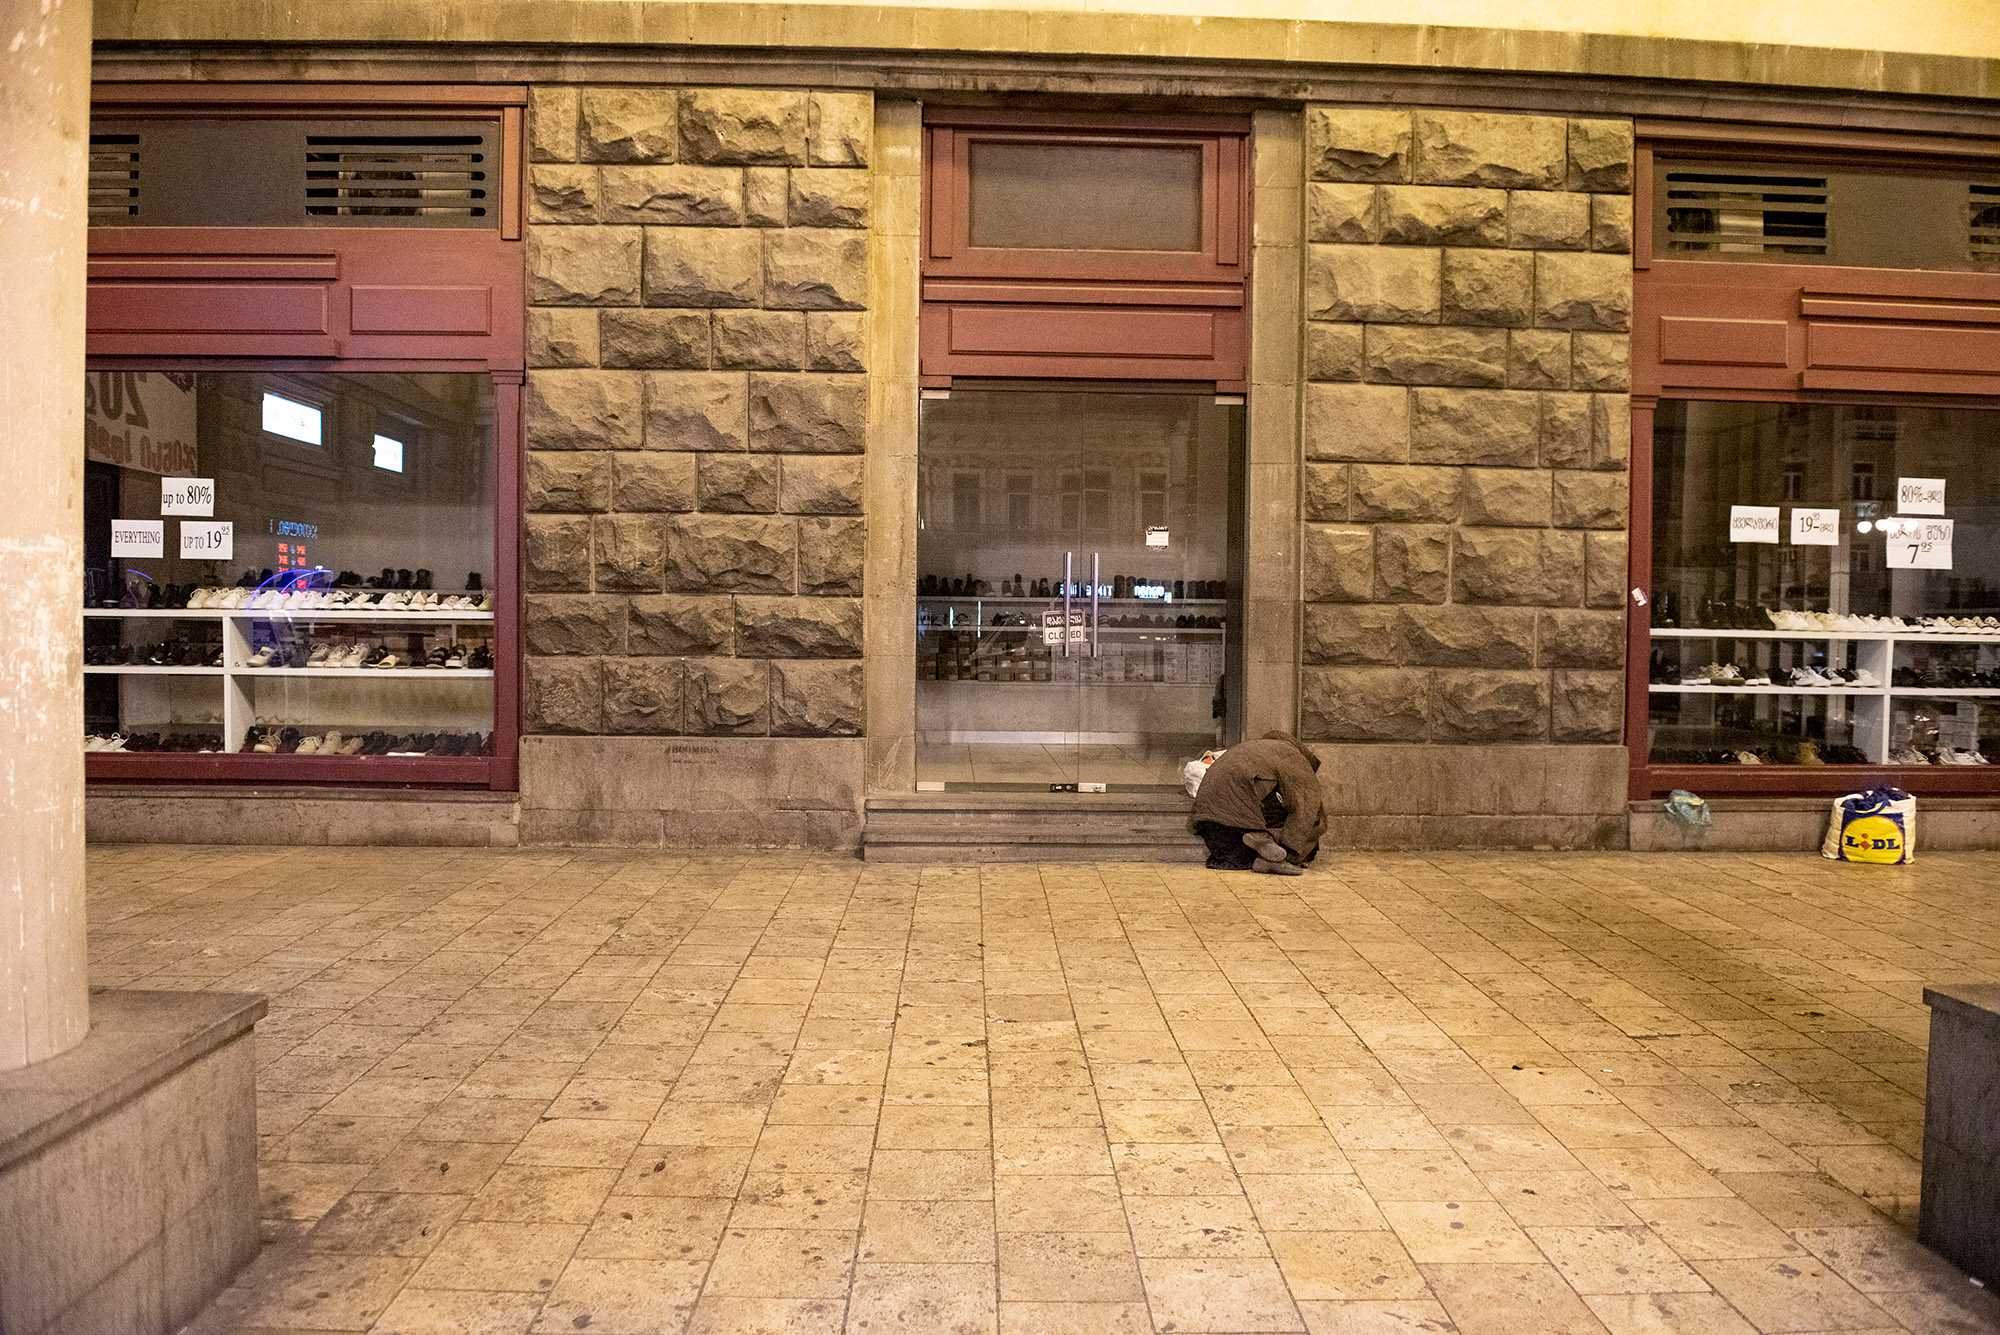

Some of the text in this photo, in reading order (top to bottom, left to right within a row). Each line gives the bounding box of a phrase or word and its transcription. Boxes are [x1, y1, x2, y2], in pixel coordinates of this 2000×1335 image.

[163, 485, 212, 507] up to 80%
[114, 530, 161, 544] EVERYTHING
[183, 536, 194, 549] UP
[194, 536, 205, 549] TO
[207, 530, 222, 549] 19
[1907, 544, 1920, 564] 7
[1048, 630, 1082, 641] CLOED
[1845, 832, 1900, 851] LIDL
